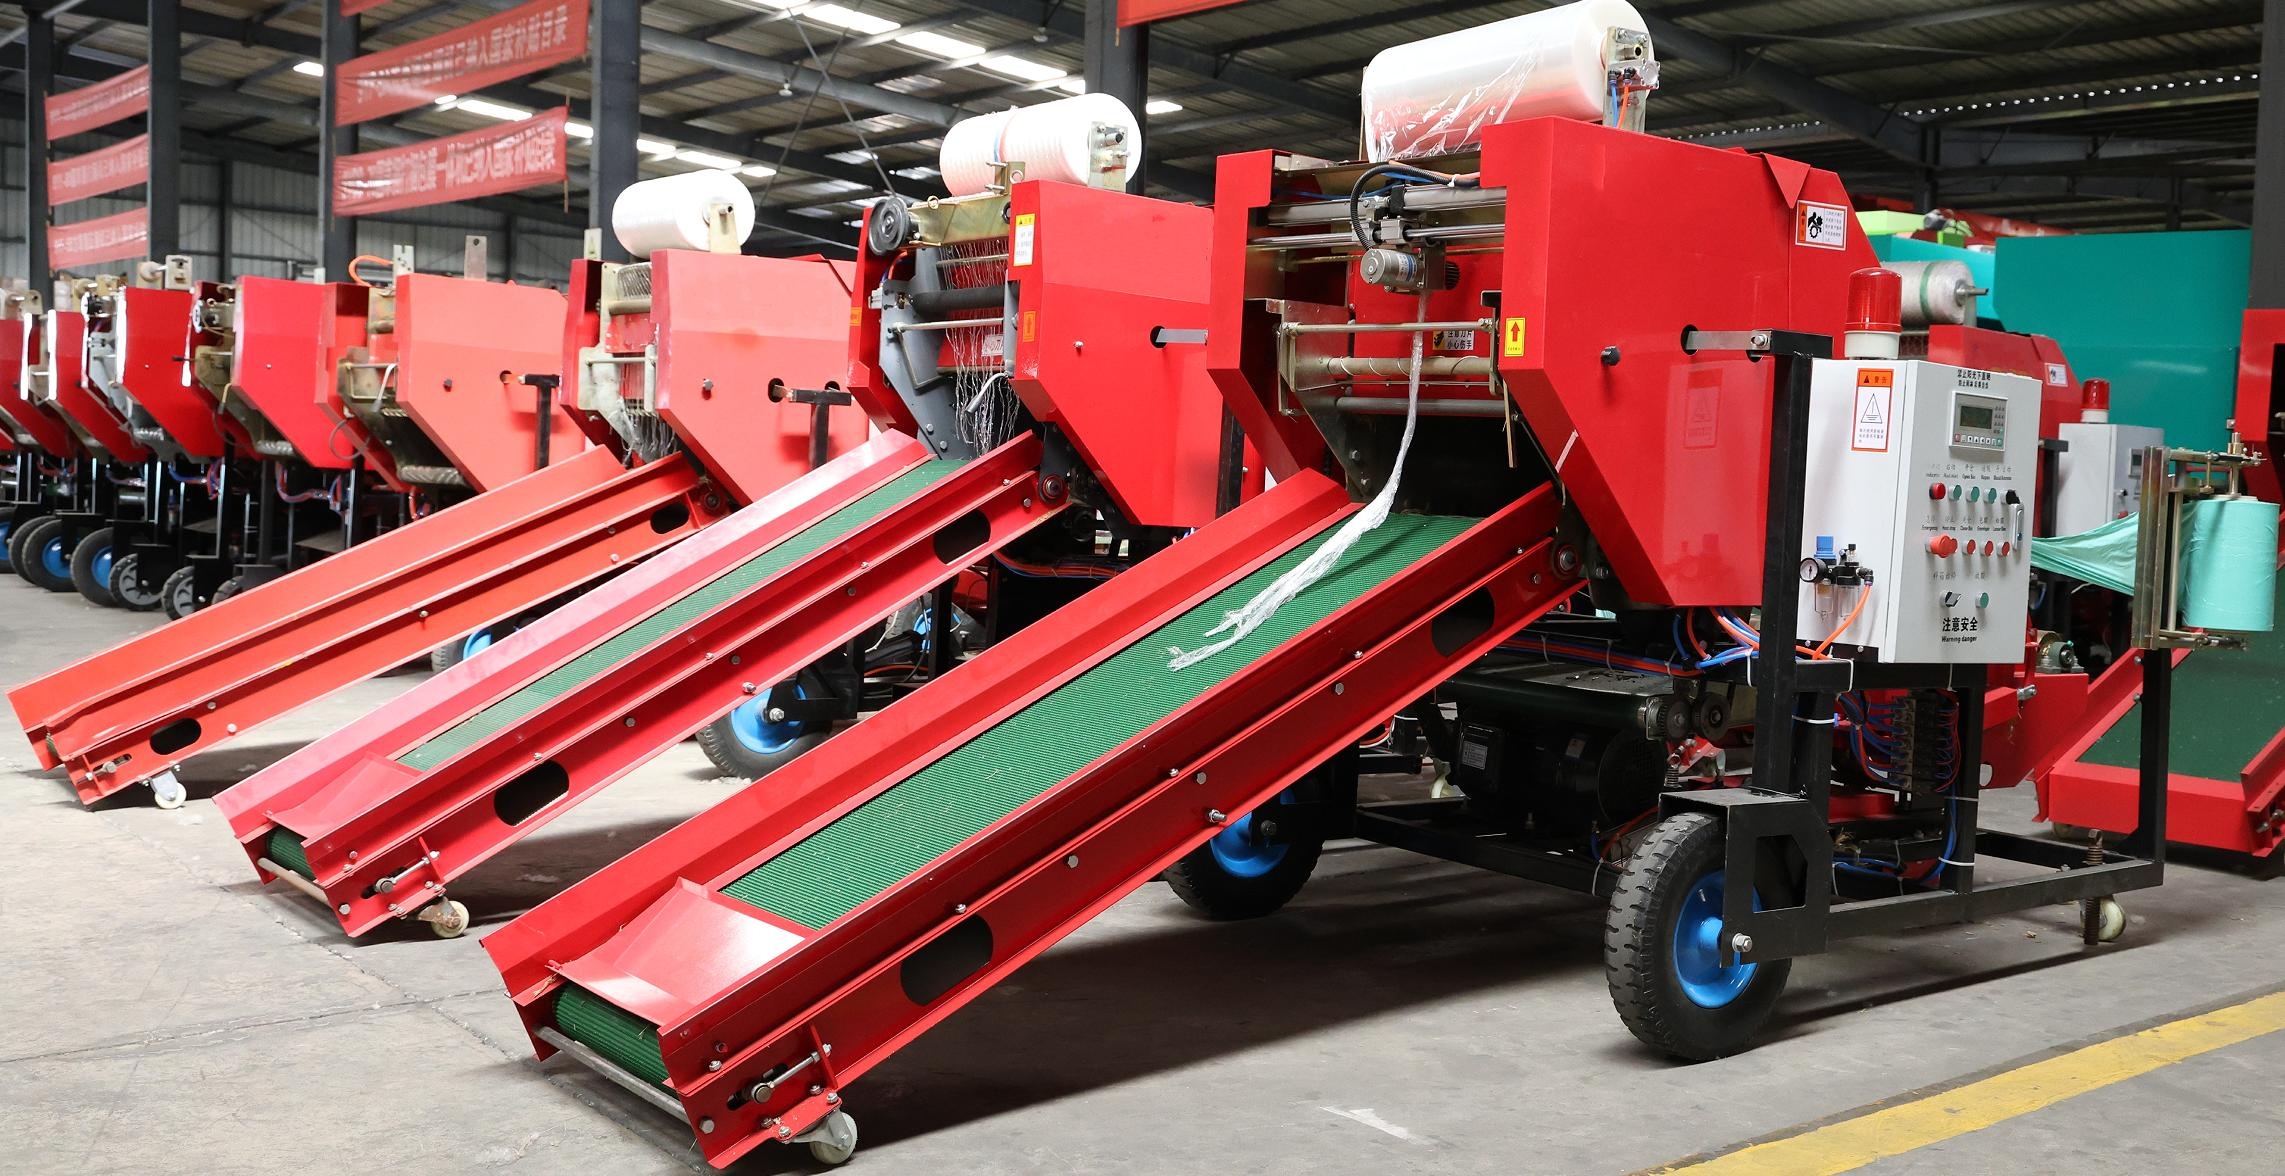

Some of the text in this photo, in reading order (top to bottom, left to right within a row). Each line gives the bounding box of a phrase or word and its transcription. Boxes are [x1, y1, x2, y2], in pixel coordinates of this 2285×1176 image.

[1942, 617, 1978, 632] 注意安全
[1942, 635, 1977, 644] Warning danger
